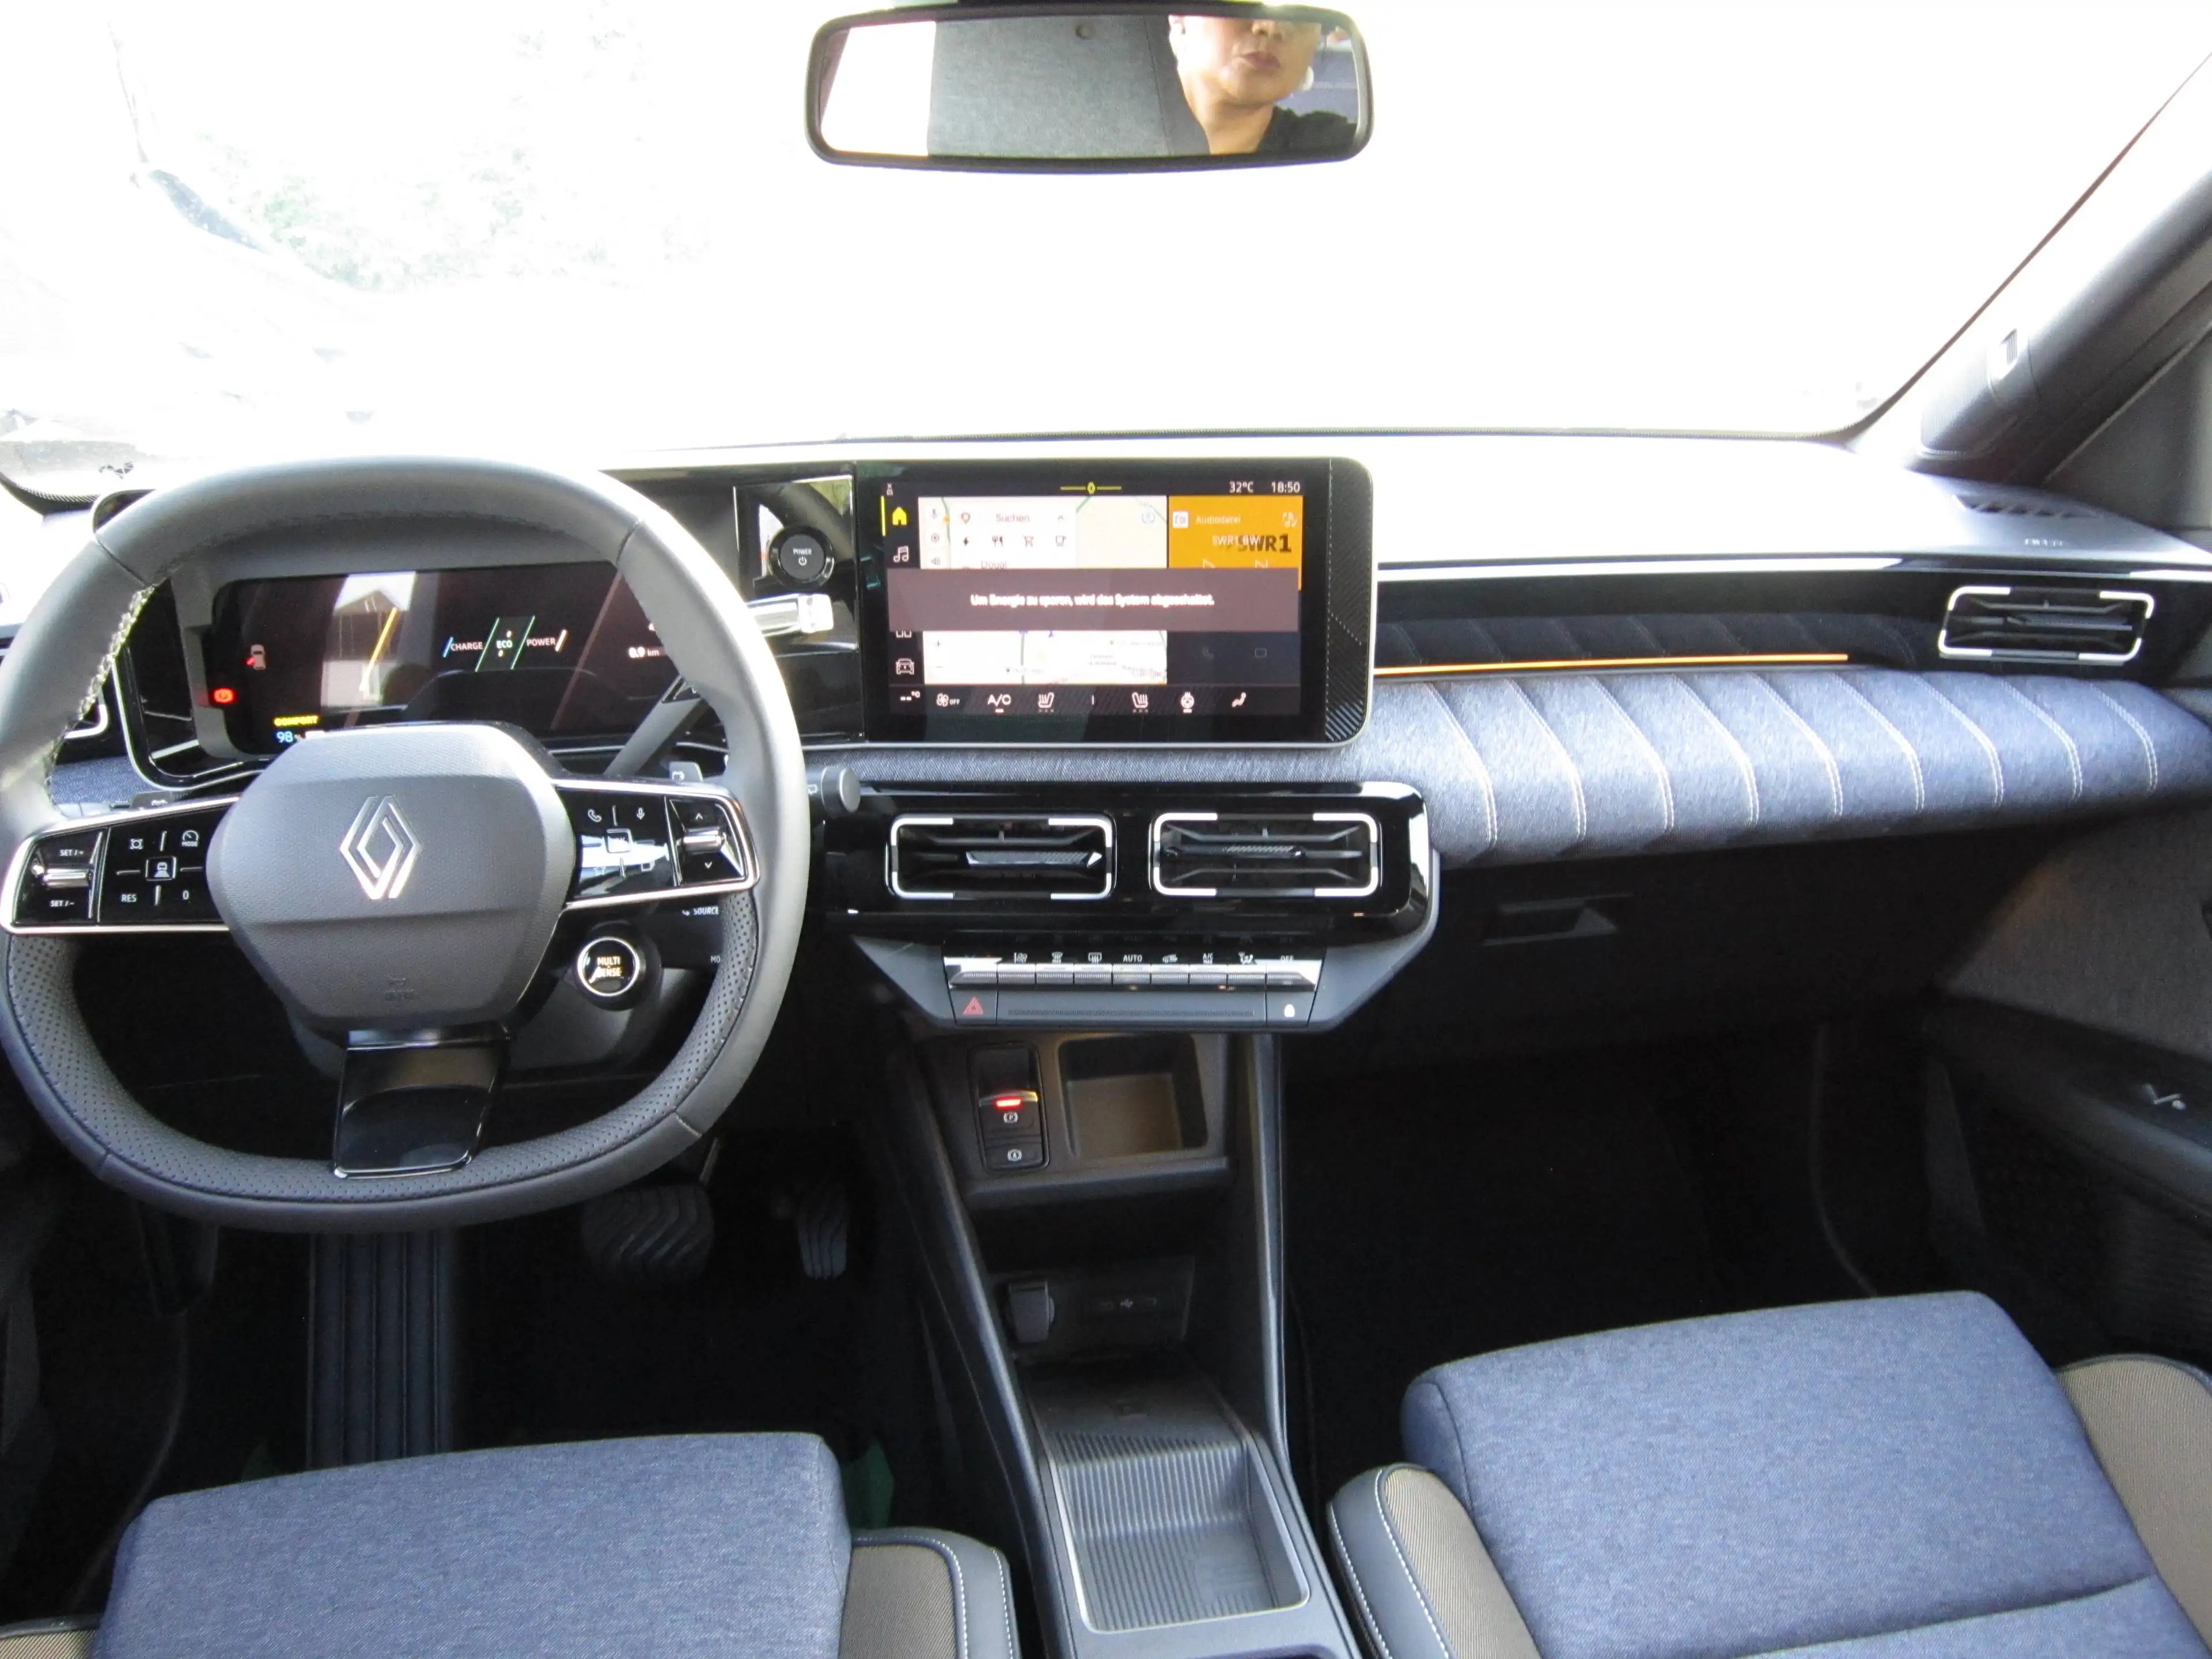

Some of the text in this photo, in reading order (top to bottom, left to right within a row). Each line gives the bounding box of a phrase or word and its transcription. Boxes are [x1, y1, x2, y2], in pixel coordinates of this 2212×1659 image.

[1271, 481, 1300, 493] 18:50
[996, 514, 1030, 522] Suchen
[450, 642, 483, 650] CHARGE
[496, 640, 513, 649] ECO
[527, 638, 556, 647] POWER
[987, 694, 1012, 707] A/C
[277, 730, 293, 743] 98
[121, 893, 137, 903] RES
[693, 906, 719, 915] SOURCE
[597, 956, 620, 966] MULTI
[1123, 955, 1142, 963] AUTO
[1281, 955, 1294, 963] OFF
